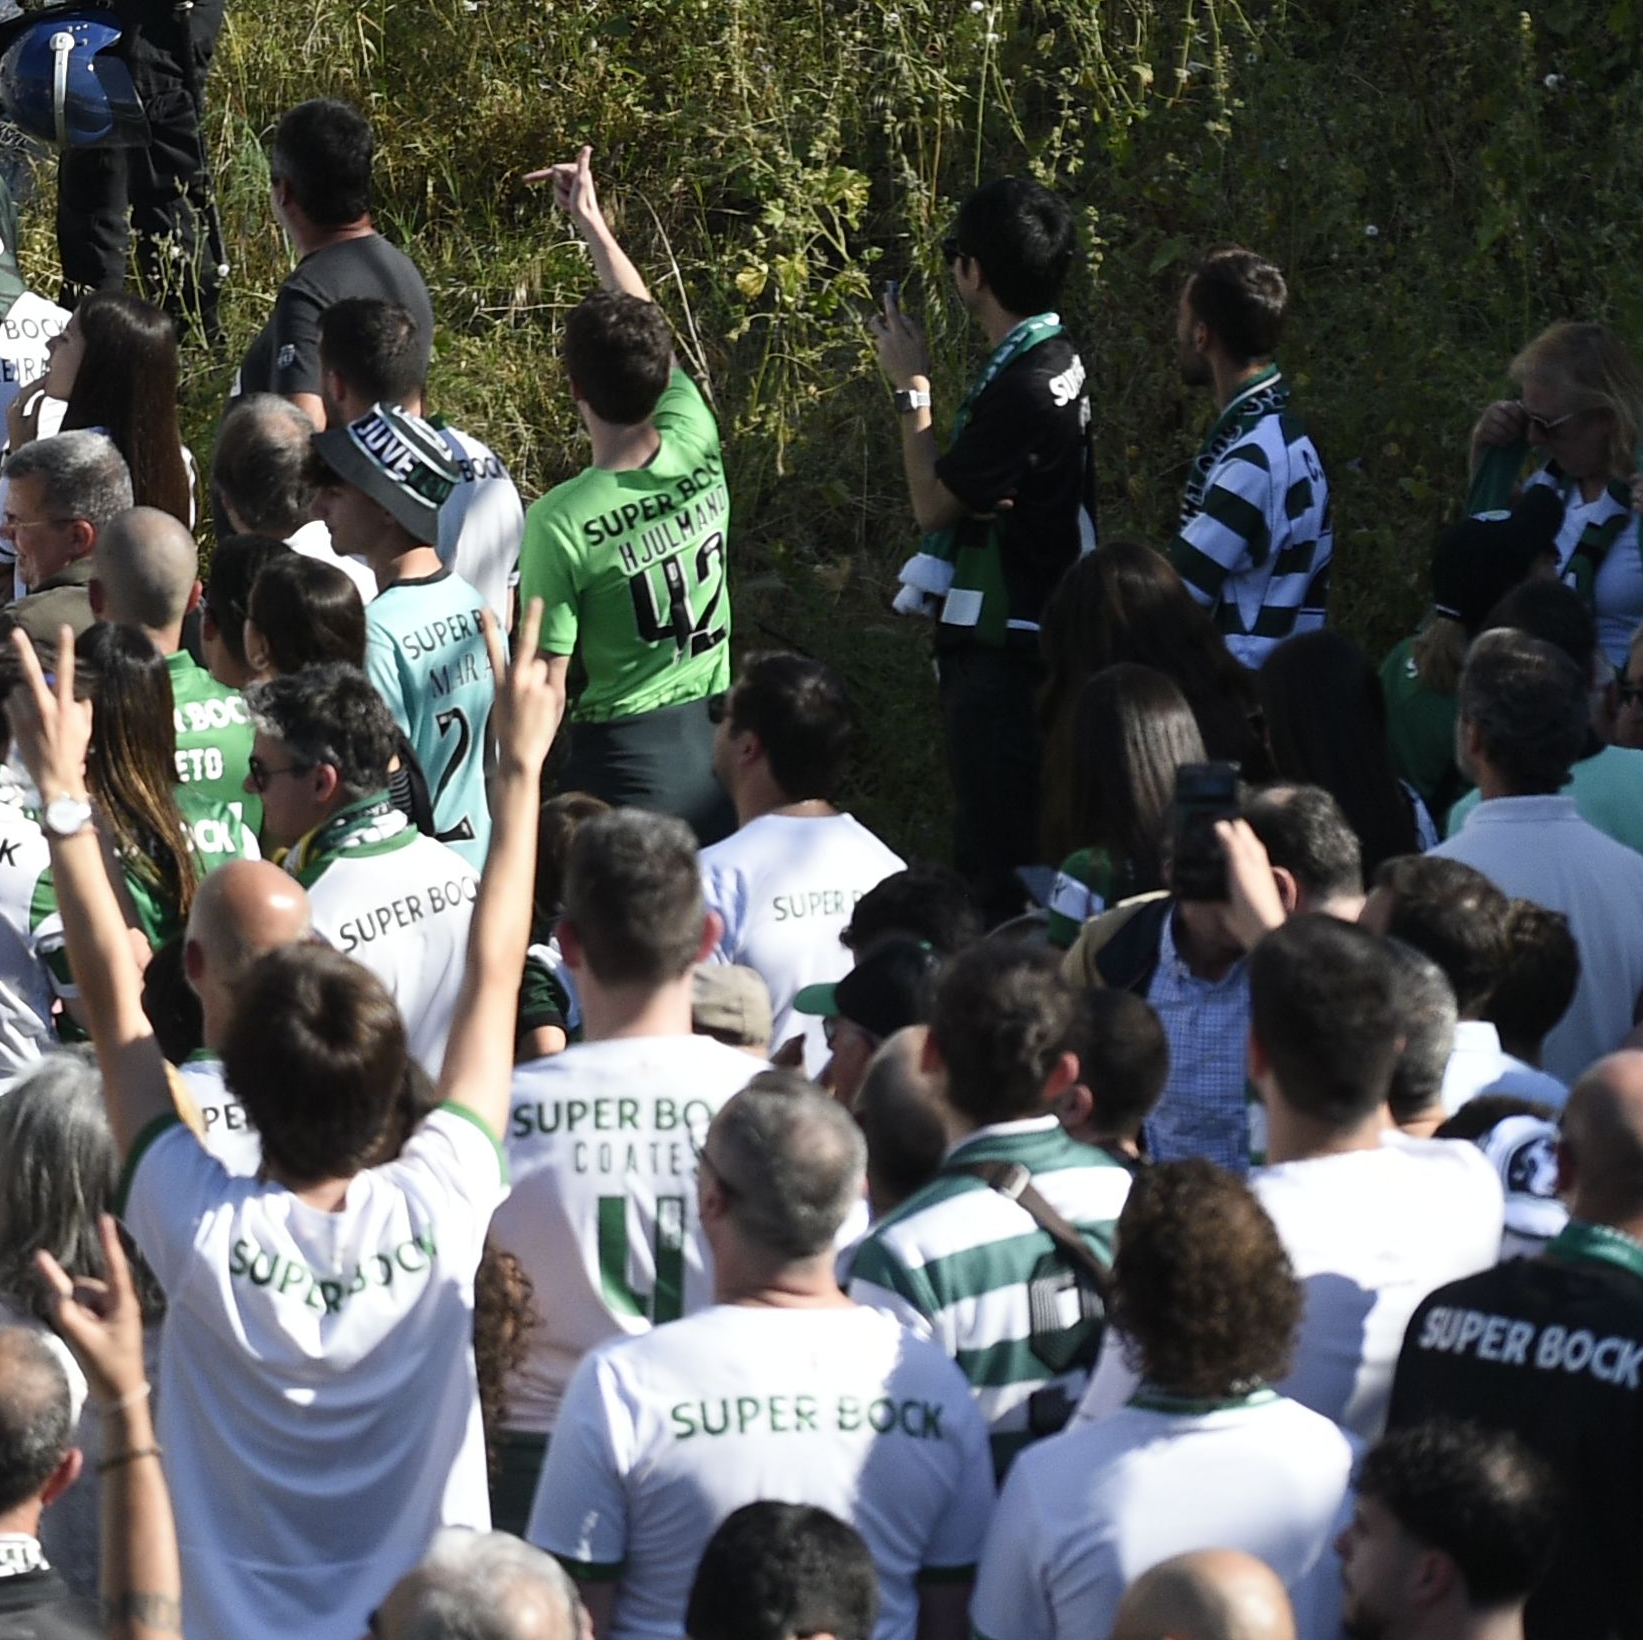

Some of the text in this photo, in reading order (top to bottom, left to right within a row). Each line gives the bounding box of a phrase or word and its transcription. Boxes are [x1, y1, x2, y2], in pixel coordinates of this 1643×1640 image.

[357, 416, 414, 481] JUVE
[584, 453, 721, 547] SUPER BOC
[619, 480, 731, 570] HJULMAND
[630, 534, 727, 666] 42
[403, 613, 473, 661] SUPER
[192, 694, 246, 728] BOC
[339, 875, 480, 953] SUPER BOC
[773, 890, 845, 922] SUPER
[514, 1099, 712, 1138] SUPER BO
[574, 1142, 682, 1176] COATE
[1419, 1306, 1643, 1389] SUPER BOCK
[671, 1397, 944, 1441] SUPER BOCK
